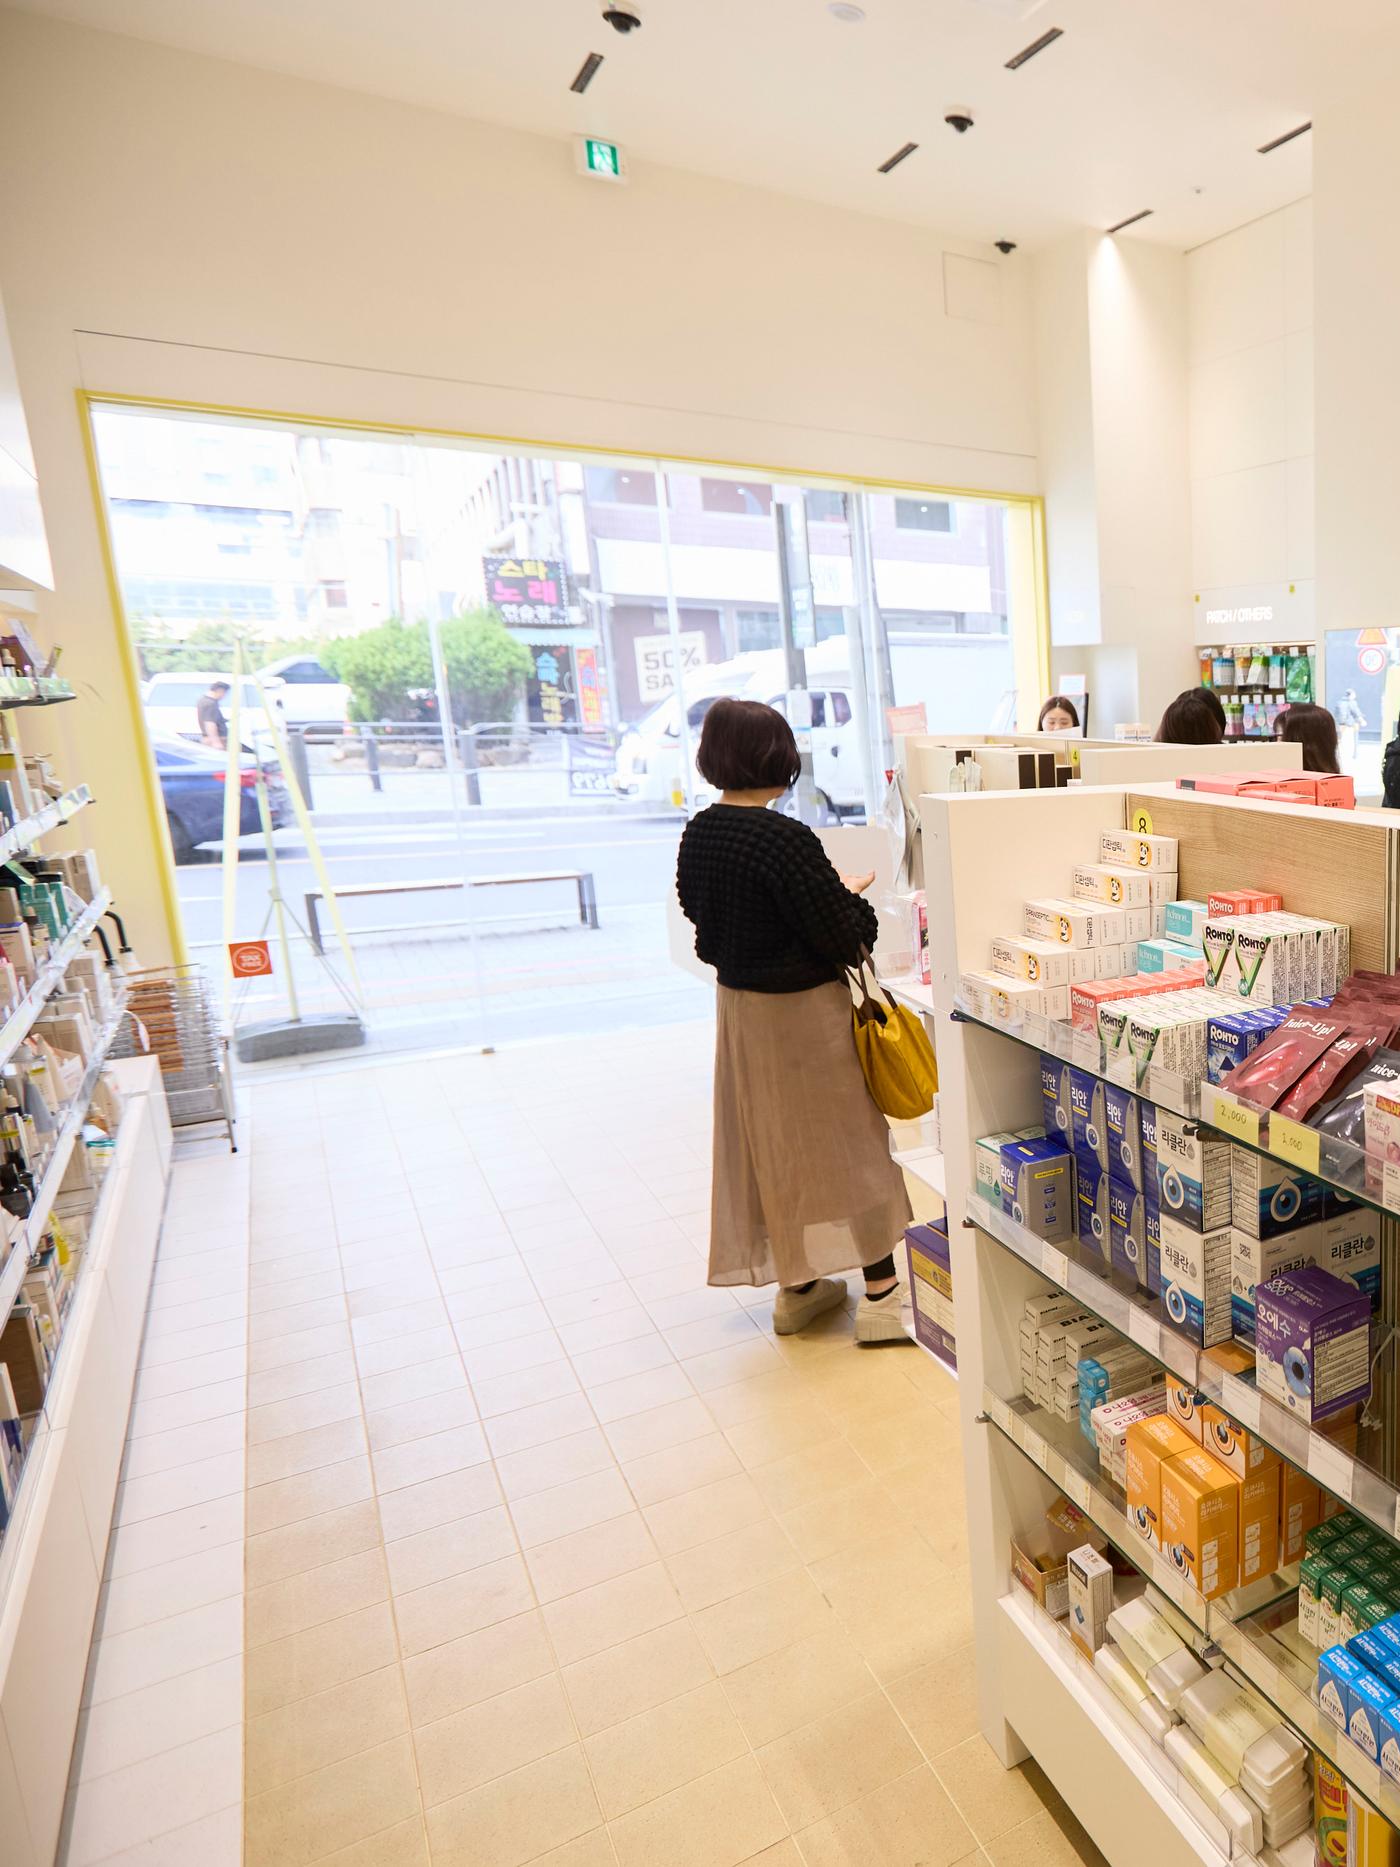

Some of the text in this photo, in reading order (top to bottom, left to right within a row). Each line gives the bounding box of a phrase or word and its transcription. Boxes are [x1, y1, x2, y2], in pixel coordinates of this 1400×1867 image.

[498, 560, 546, 580] 스타
[1206, 608, 1232, 624] PATCH
[1238, 606, 1273, 622] OTHERS
[1210, 898, 1233, 912] ROHTO
[1206, 926, 1233, 942] ROHTO
[1238, 934, 1266, 950] ROHTO
[1071, 991, 1095, 1009] ROHTO
[1100, 1010, 1125, 1032] ROHTO
[1131, 1024, 1156, 1044] ROHTO
[1210, 1025, 1239, 1045] ROHTO
[1041, 1072, 1056, 1090] 리안
[1071, 1087, 1088, 1109] 리안
[1106, 1102, 1122, 1124] 리안
[1162, 1129, 1187, 1156] 리클란
[1000, 1164, 1014, 1186] 리안
[1110, 1197, 1127, 1218] 리안
[1331, 1236, 1364, 1260] 리클란
[1165, 1246, 1189, 1274] 리클란
